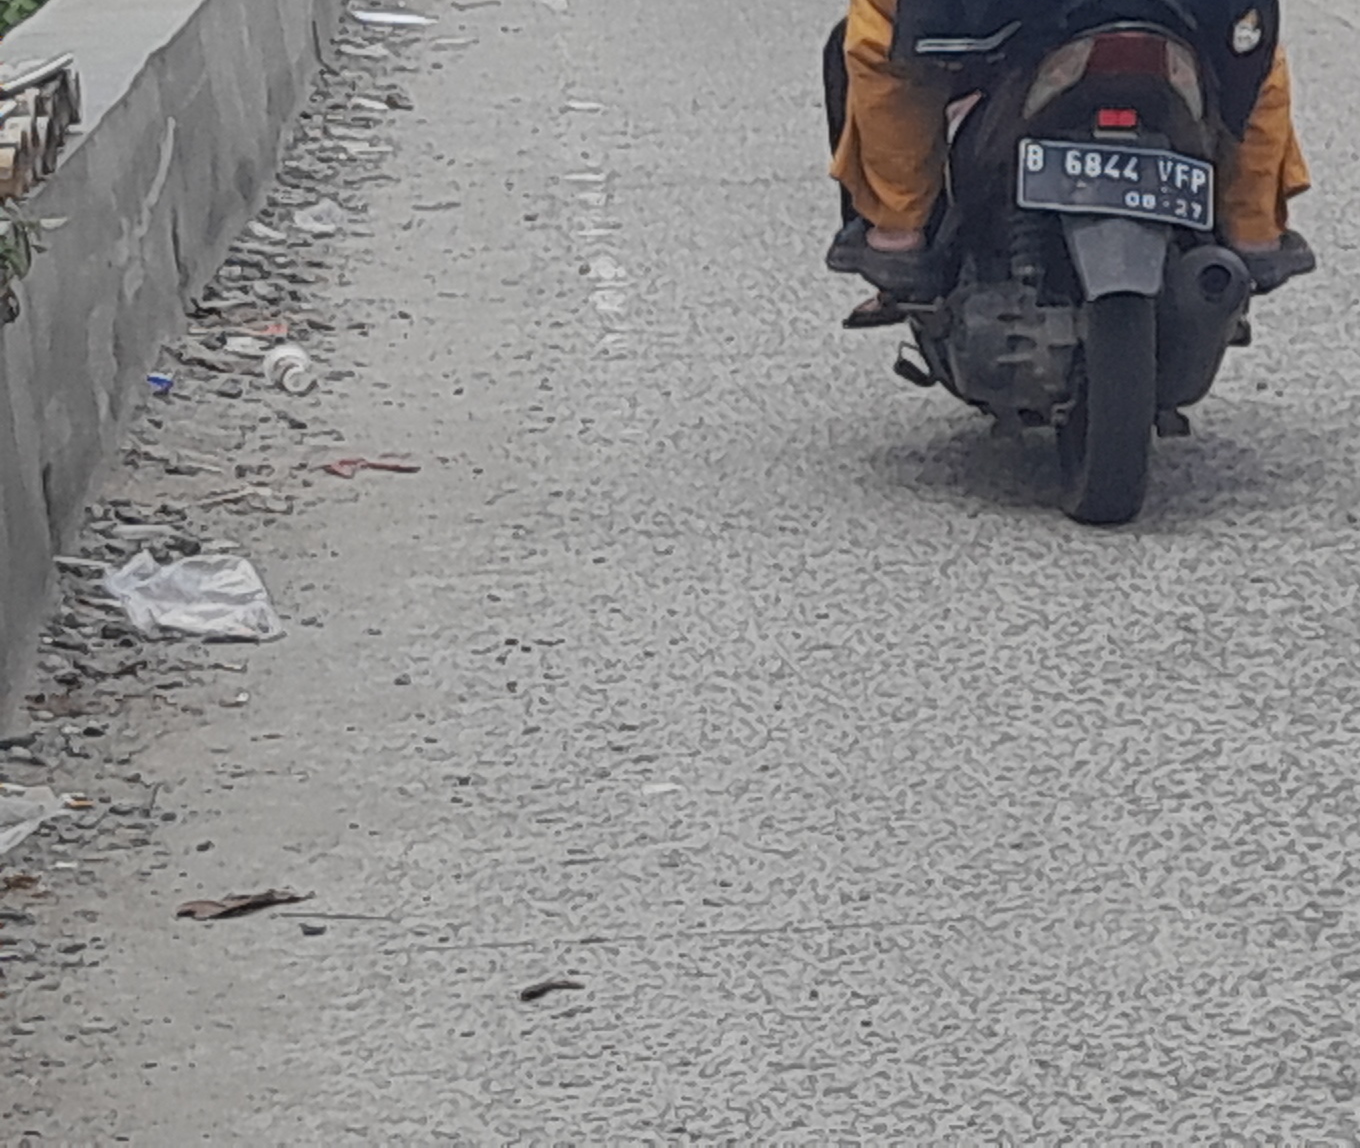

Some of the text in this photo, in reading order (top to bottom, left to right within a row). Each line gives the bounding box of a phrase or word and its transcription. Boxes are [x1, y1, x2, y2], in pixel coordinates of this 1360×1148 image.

[1026, 143, 1207, 194] B 6844 VFP
